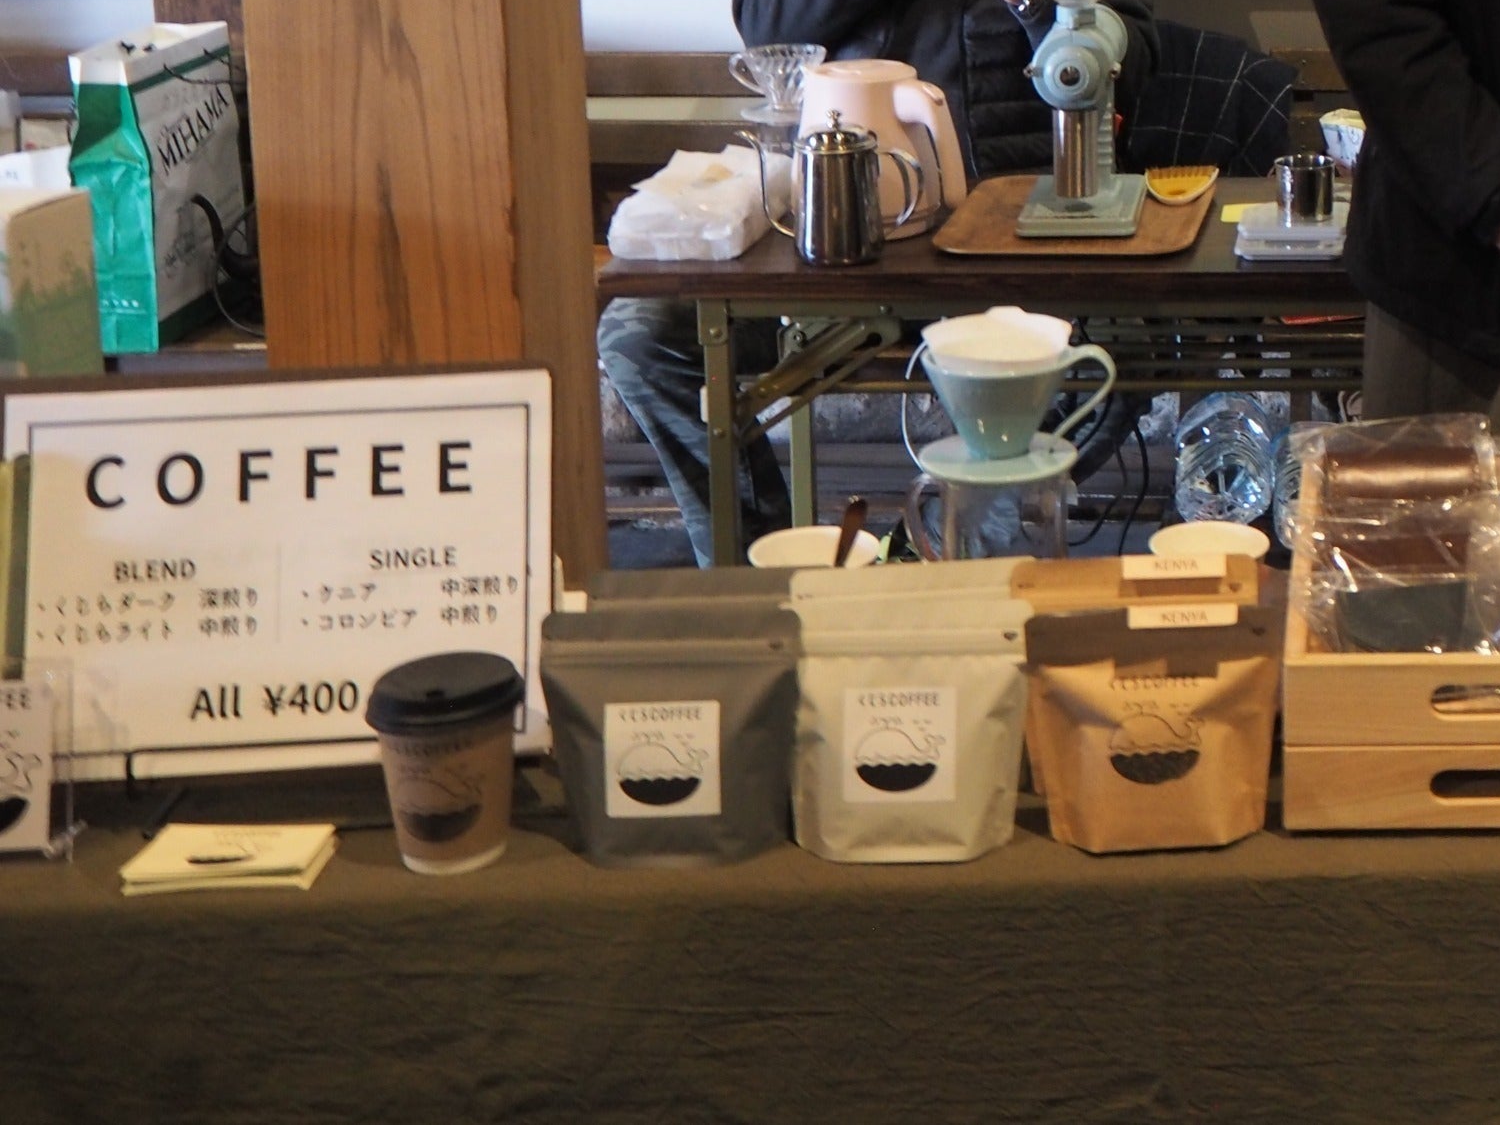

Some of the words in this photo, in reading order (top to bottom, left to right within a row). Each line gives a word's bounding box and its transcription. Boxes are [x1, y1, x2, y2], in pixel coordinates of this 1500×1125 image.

[156, 85, 230, 177] MIHAMA
[85, 441, 473, 510] COFFEE
[113, 557, 197, 583] BLEND
[369, 545, 458, 571] SINGLE
[1154, 558, 1200, 571] KENYA
[1160, 610, 1209, 624] KENYA
[189, 683, 243, 720] All
[262, 680, 361, 717] ¥400
